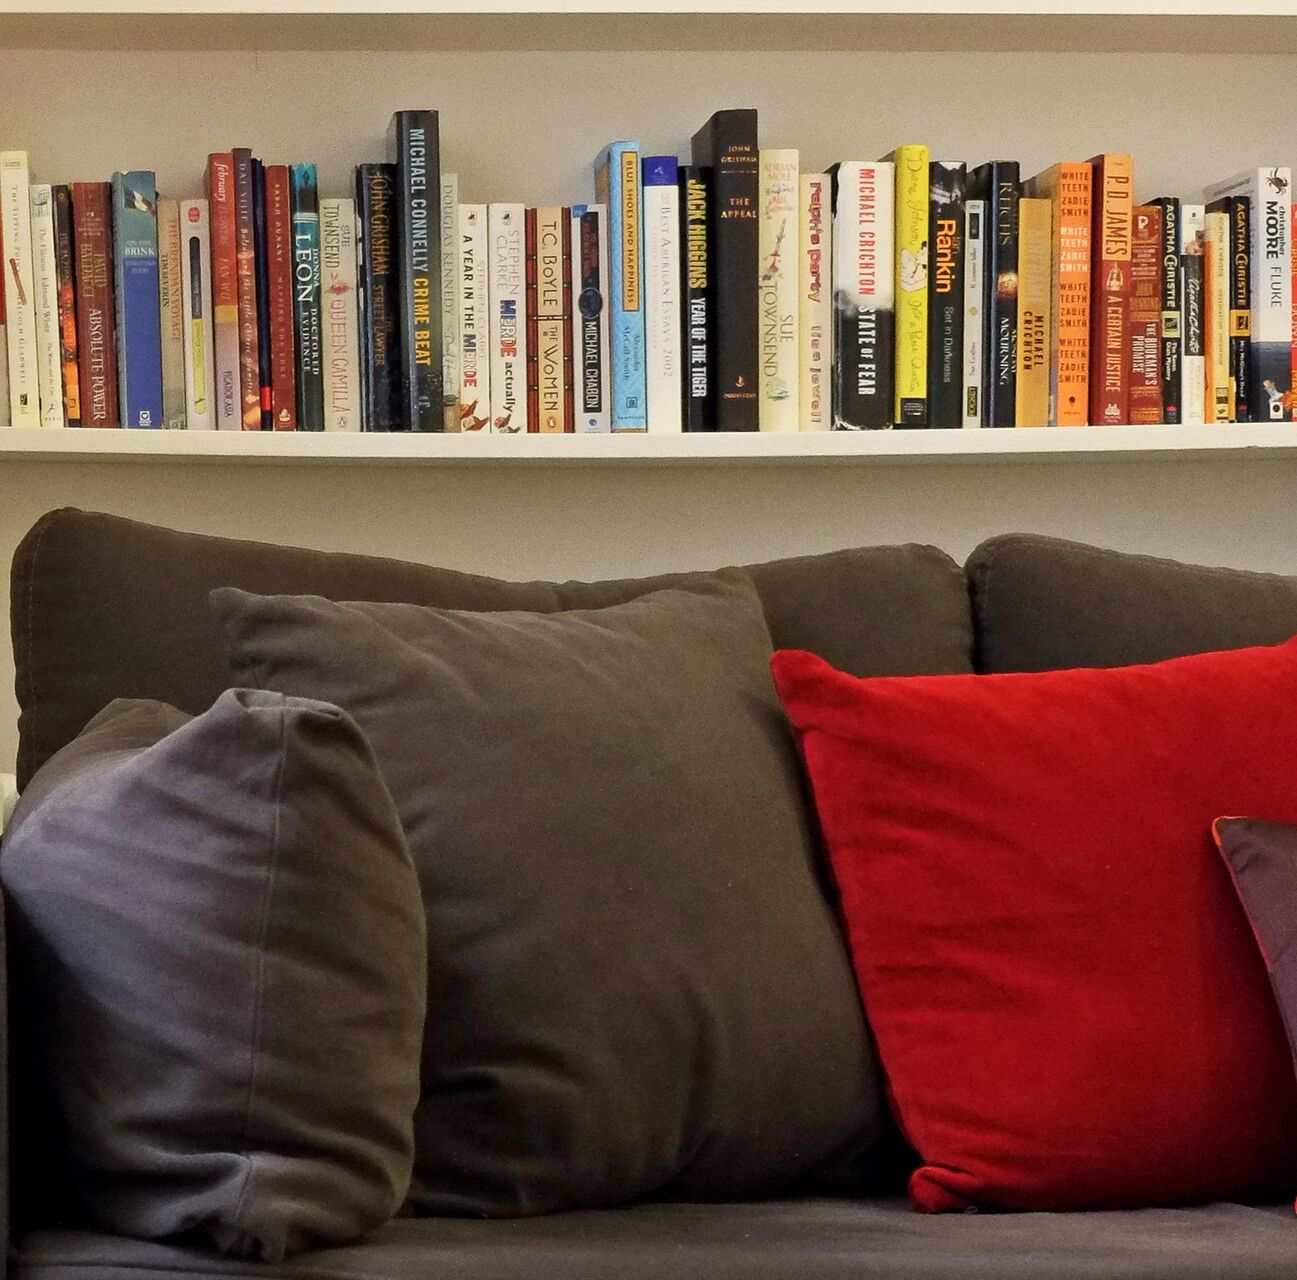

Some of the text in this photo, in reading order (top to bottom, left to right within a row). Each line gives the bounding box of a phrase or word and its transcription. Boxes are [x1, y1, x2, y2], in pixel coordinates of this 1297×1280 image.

[215, 162, 228, 202] february
[1061, 172, 1089, 180] WHITE
[1061, 184, 1089, 192] TEETH
[1061, 197, 1089, 205] ZADIE
[1106, 191, 1129, 203] D.
[1107, 176, 1129, 184] P.
[370, 172, 391, 276] JOHN GRISHAM
[626, 189, 634, 218] SHOES
[721, 210, 756, 218] APPEAL
[999, 182, 1013, 246] REICHS
[125, 247, 155, 256] BRINK
[323, 204, 340, 269] TOWNSEND
[341, 224, 351, 248] SUE
[410, 129, 431, 366] MICHAEL CONNELLY CRIME BEAT
[443, 184, 455, 316] DOUGLAS KENNEDY
[953, 236, 962, 254] Ian
[1061, 227, 1088, 236] WHITE
[1061, 239, 1088, 248] TEETH
[1106, 210, 1128, 255] JAMES
[1235, 203, 1248, 306] AGATHA CHRISTIE
[1267, 201, 1279, 259] MOORE
[1278, 206, 1286, 256] christopher
[80, 242, 95, 297] BALDACCI
[92, 253, 107, 287] DAVID
[295, 234, 313, 302] LEON
[496, 235, 508, 292] CLARKE
[508, 230, 520, 295] STEPHEN
[627, 250, 635, 304] HAPPINESS
[808, 249, 822, 303] party
[936, 219, 958, 293] Rankin
[1061, 252, 1088, 260] ZADIE
[1061, 264, 1088, 272] SMITH
[1164, 205, 1177, 308] AGATHA CHRISTIE
[543, 256, 558, 307] BOYLE
[688, 179, 707, 398] JACK HIGGINS YEAR OF THE TIGER
[858, 169, 876, 395] MICHAEL CRICHTON STATE FEAR
[1060, 283, 1087, 291] WHITE
[1060, 295, 1087, 303] TEETH
[1271, 267, 1282, 308] FLUKE
[464, 235, 477, 388] A YEAR IN THE MERDE
[764, 281, 777, 377] TOWNSEND
[780, 315, 794, 343] SUE
[1060, 308, 1087, 316] ZADIE
[1107, 307, 1123, 349] CERTAIN
[89, 308, 107, 421] ABSOLUTE POWER
[302, 312, 310, 372] EVIDENCE
[311, 309, 319, 375] DOCTORED
[330, 300, 351, 414] QUEEN CAMILLA
[500, 300, 517, 413] MERDE actually
[585, 322, 599, 408] MICHAEL CHABON
[944, 306, 954, 383] Set in Darkness
[1000, 317, 1011, 385] MOURNING
[1023, 311, 1033, 370] CRICHTON
[1033, 315, 1045, 367] MICHAEL
[1059, 339, 1087, 347] WHITE
[1059, 350, 1087, 359] TEETH
[1132, 335, 1145, 373] PROMISE
[1145, 338, 1158, 385] BOOKMAN'S
[544, 344, 559, 411] WOMEN
[1059, 363, 1087, 371] ZADIE
[1059, 375, 1087, 383] SMITH
[1106, 353, 1123, 393] JUSTICE
